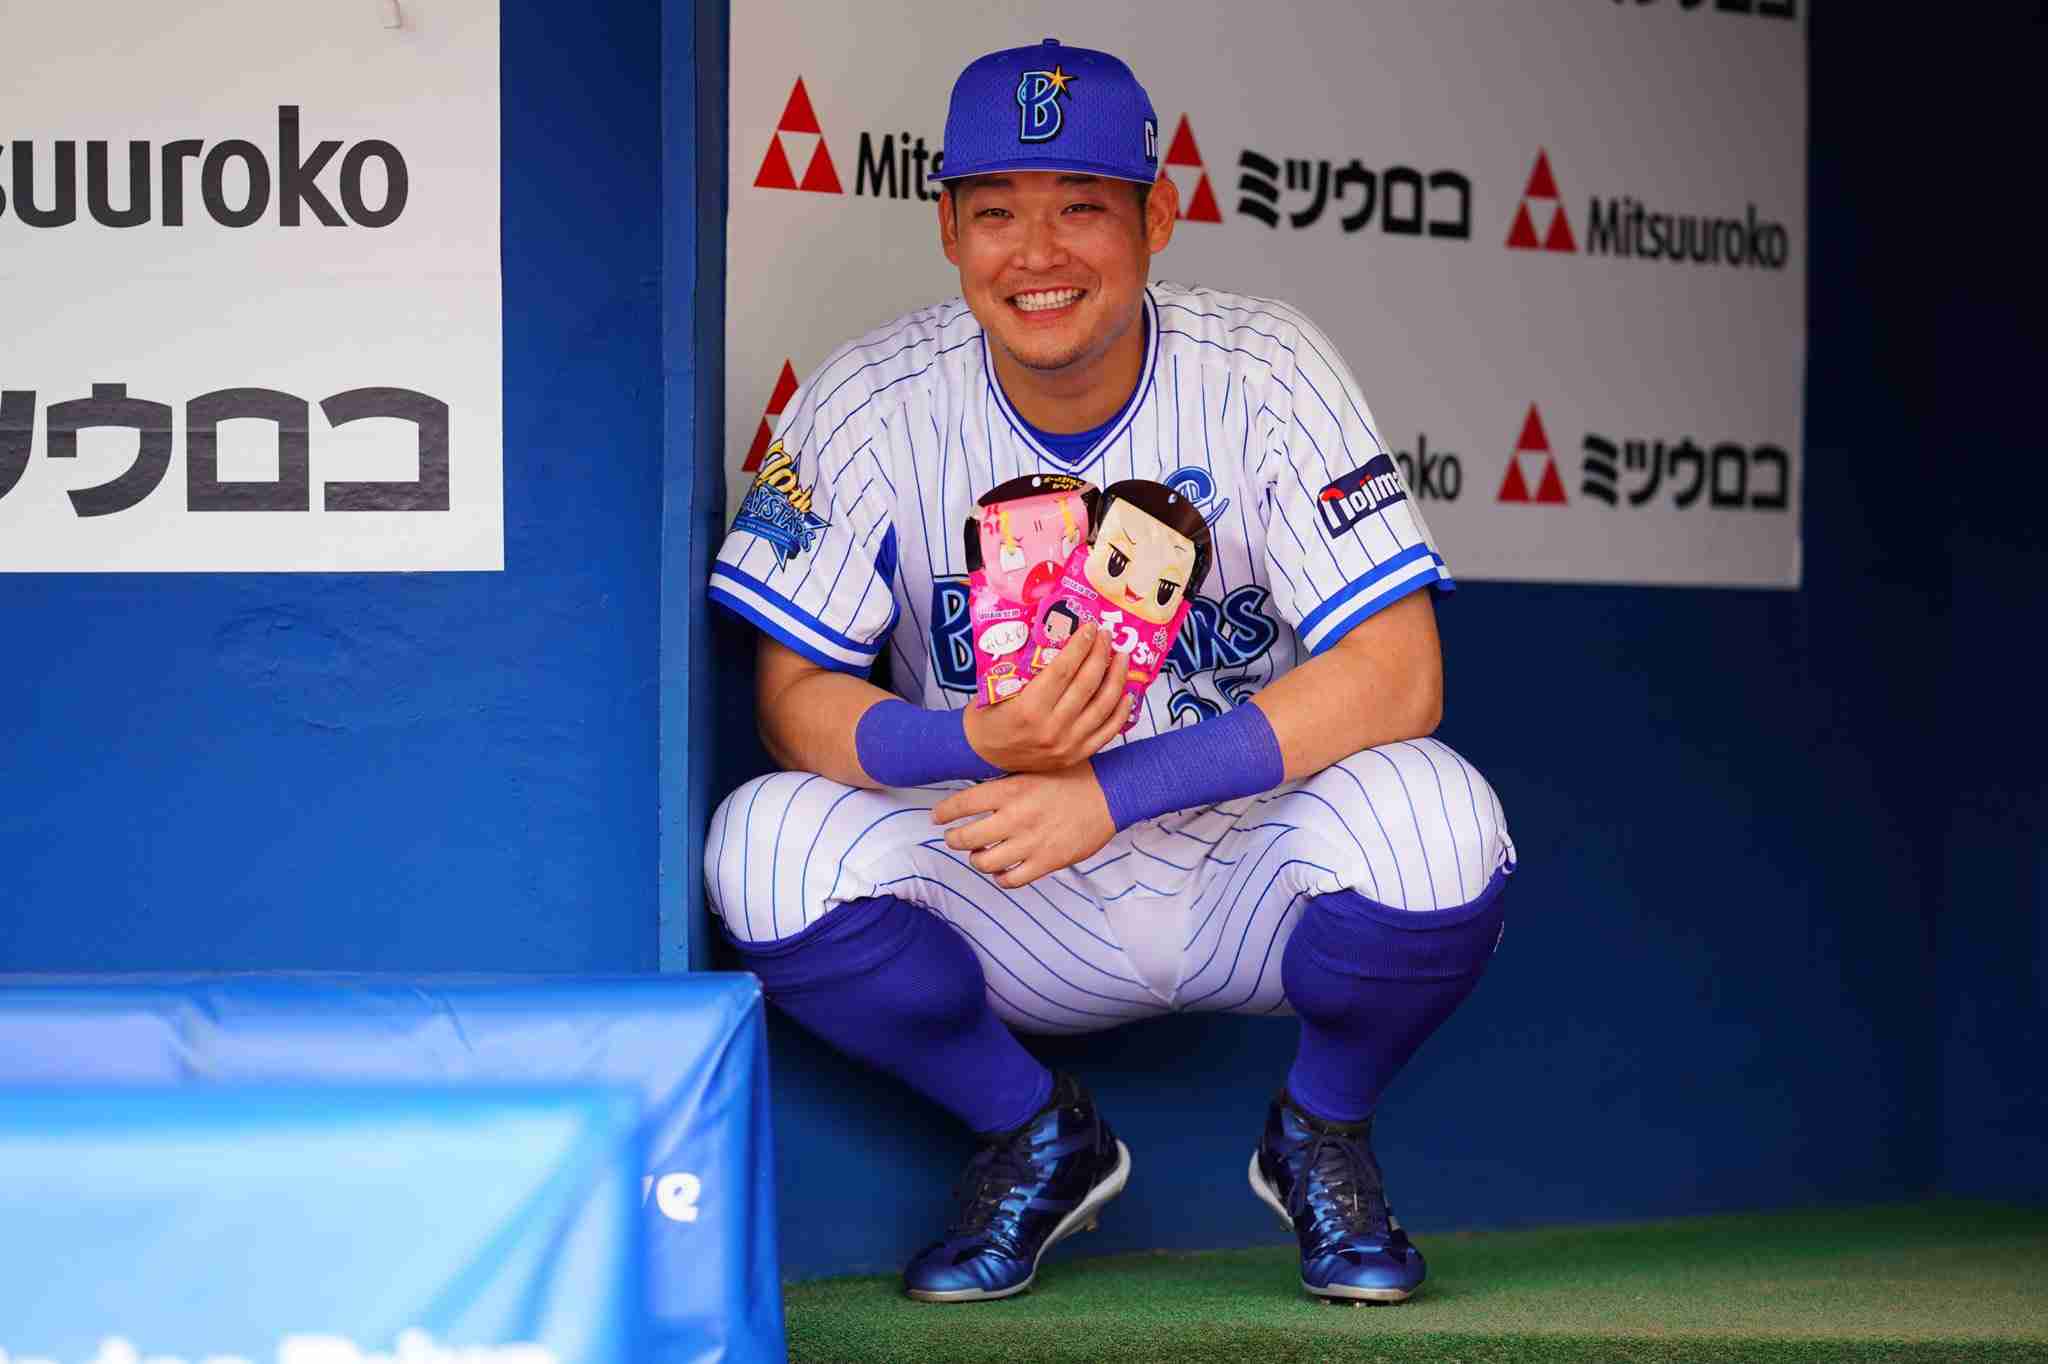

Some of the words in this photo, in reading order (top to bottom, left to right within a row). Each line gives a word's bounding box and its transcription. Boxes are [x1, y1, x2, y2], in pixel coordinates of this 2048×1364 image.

[1017, 65, 1077, 144] B
[0, 105, 409, 228] uuroko
[1237, 149, 1472, 240] ミツウロコ
[1587, 197, 1789, 270] Mitsuuroko
[0, 383, 450, 517] ウロコ
[1582, 433, 1789, 512] ミツウロコ
